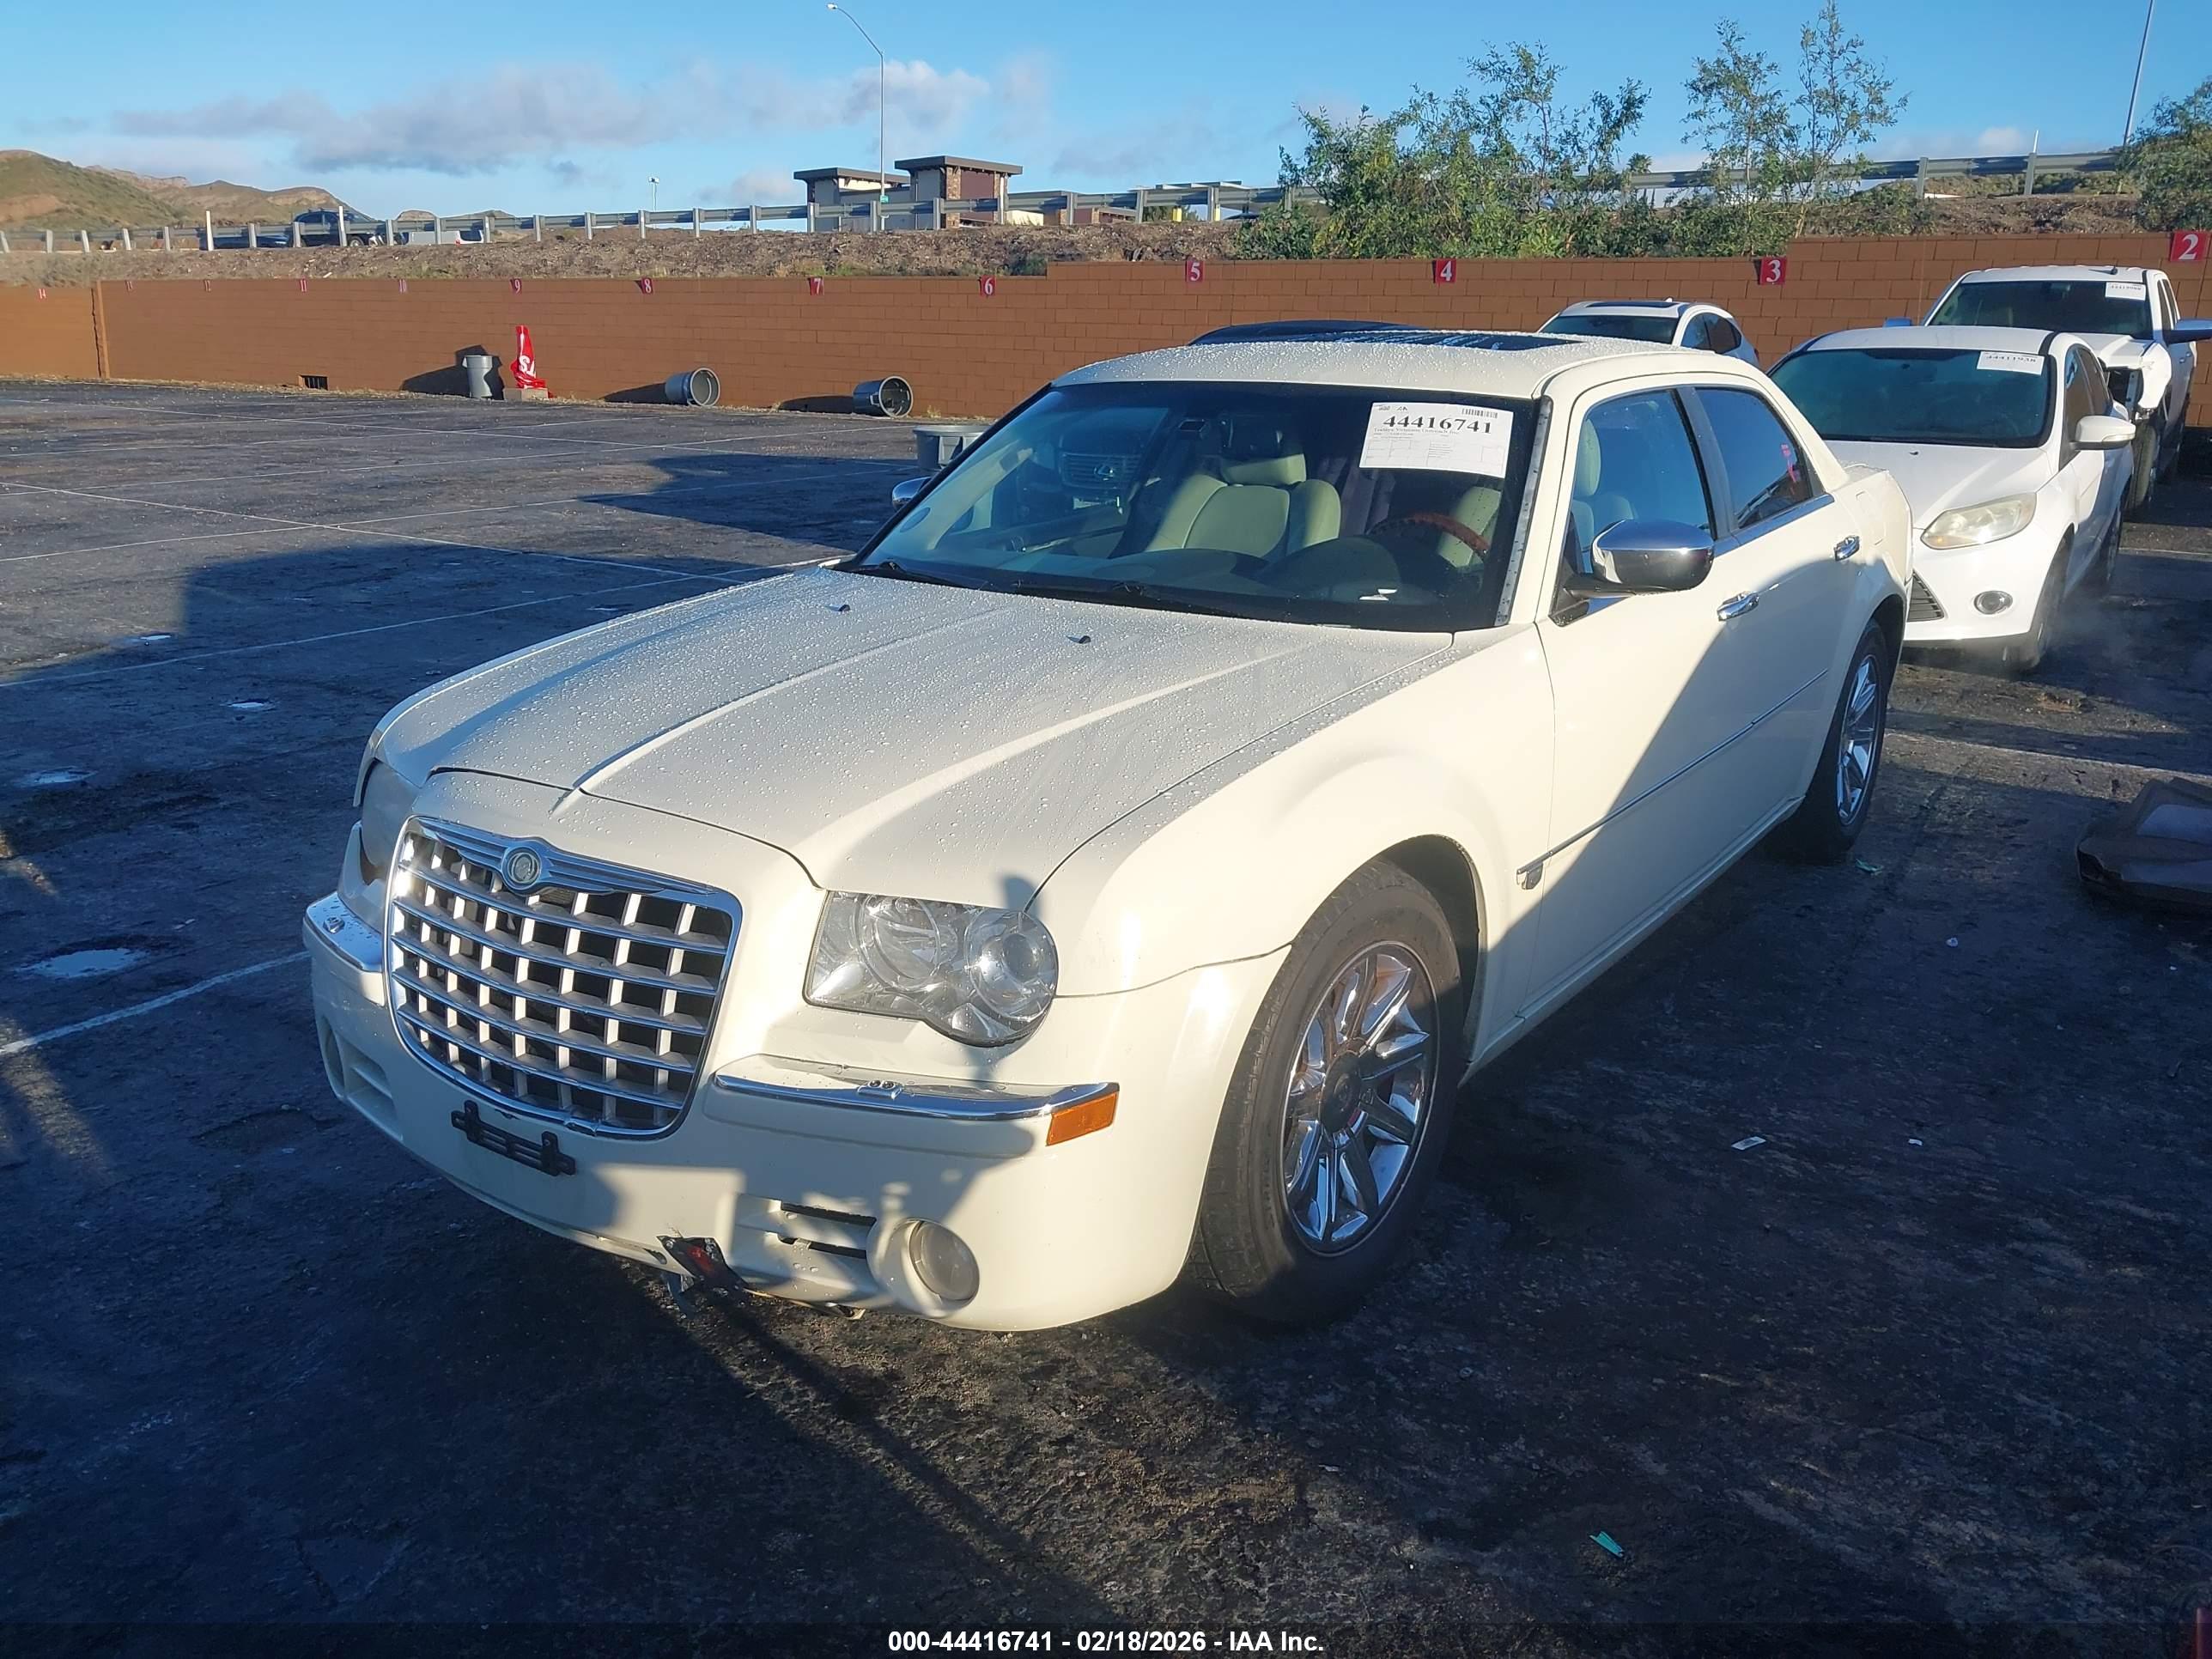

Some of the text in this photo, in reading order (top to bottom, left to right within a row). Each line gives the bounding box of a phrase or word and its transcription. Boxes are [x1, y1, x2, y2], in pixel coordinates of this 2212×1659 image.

[2178, 234, 2199, 260] 2
[1190, 262, 1200, 282] 5
[1440, 260, 1452, 282] 4
[1765, 259, 1781, 283] 3
[514, 279, 520, 294] 9
[644, 278, 652, 294] 8
[813, 278, 822, 295] 7
[984, 279, 993, 295] 6
[1383, 416, 1492, 434] 44416741
